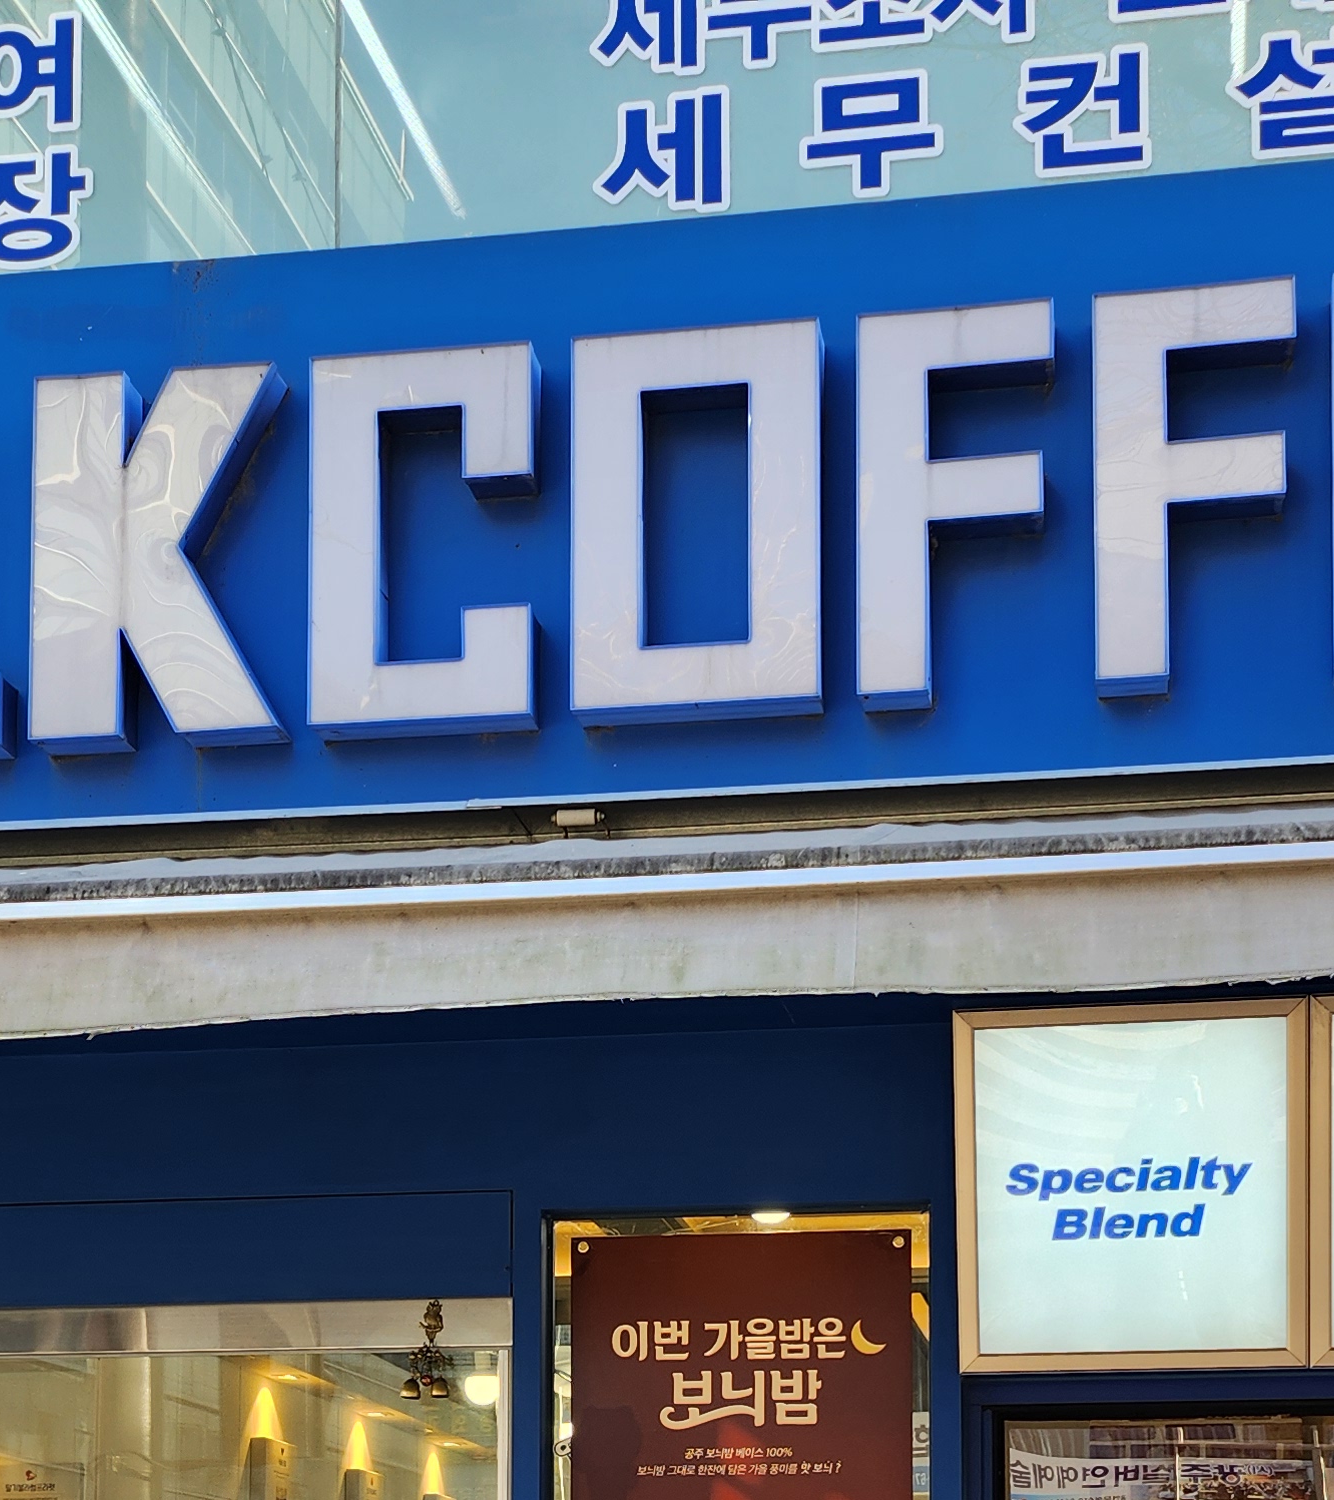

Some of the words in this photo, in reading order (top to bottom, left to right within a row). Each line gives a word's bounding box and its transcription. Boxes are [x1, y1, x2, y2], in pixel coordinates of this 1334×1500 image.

[1005, 1156, 1253, 1201] Specialty
[1051, 1203, 1206, 1241] Blend
[612, 1320, 690, 1361] 이번
[704, 1317, 847, 1361] 가을밤은
